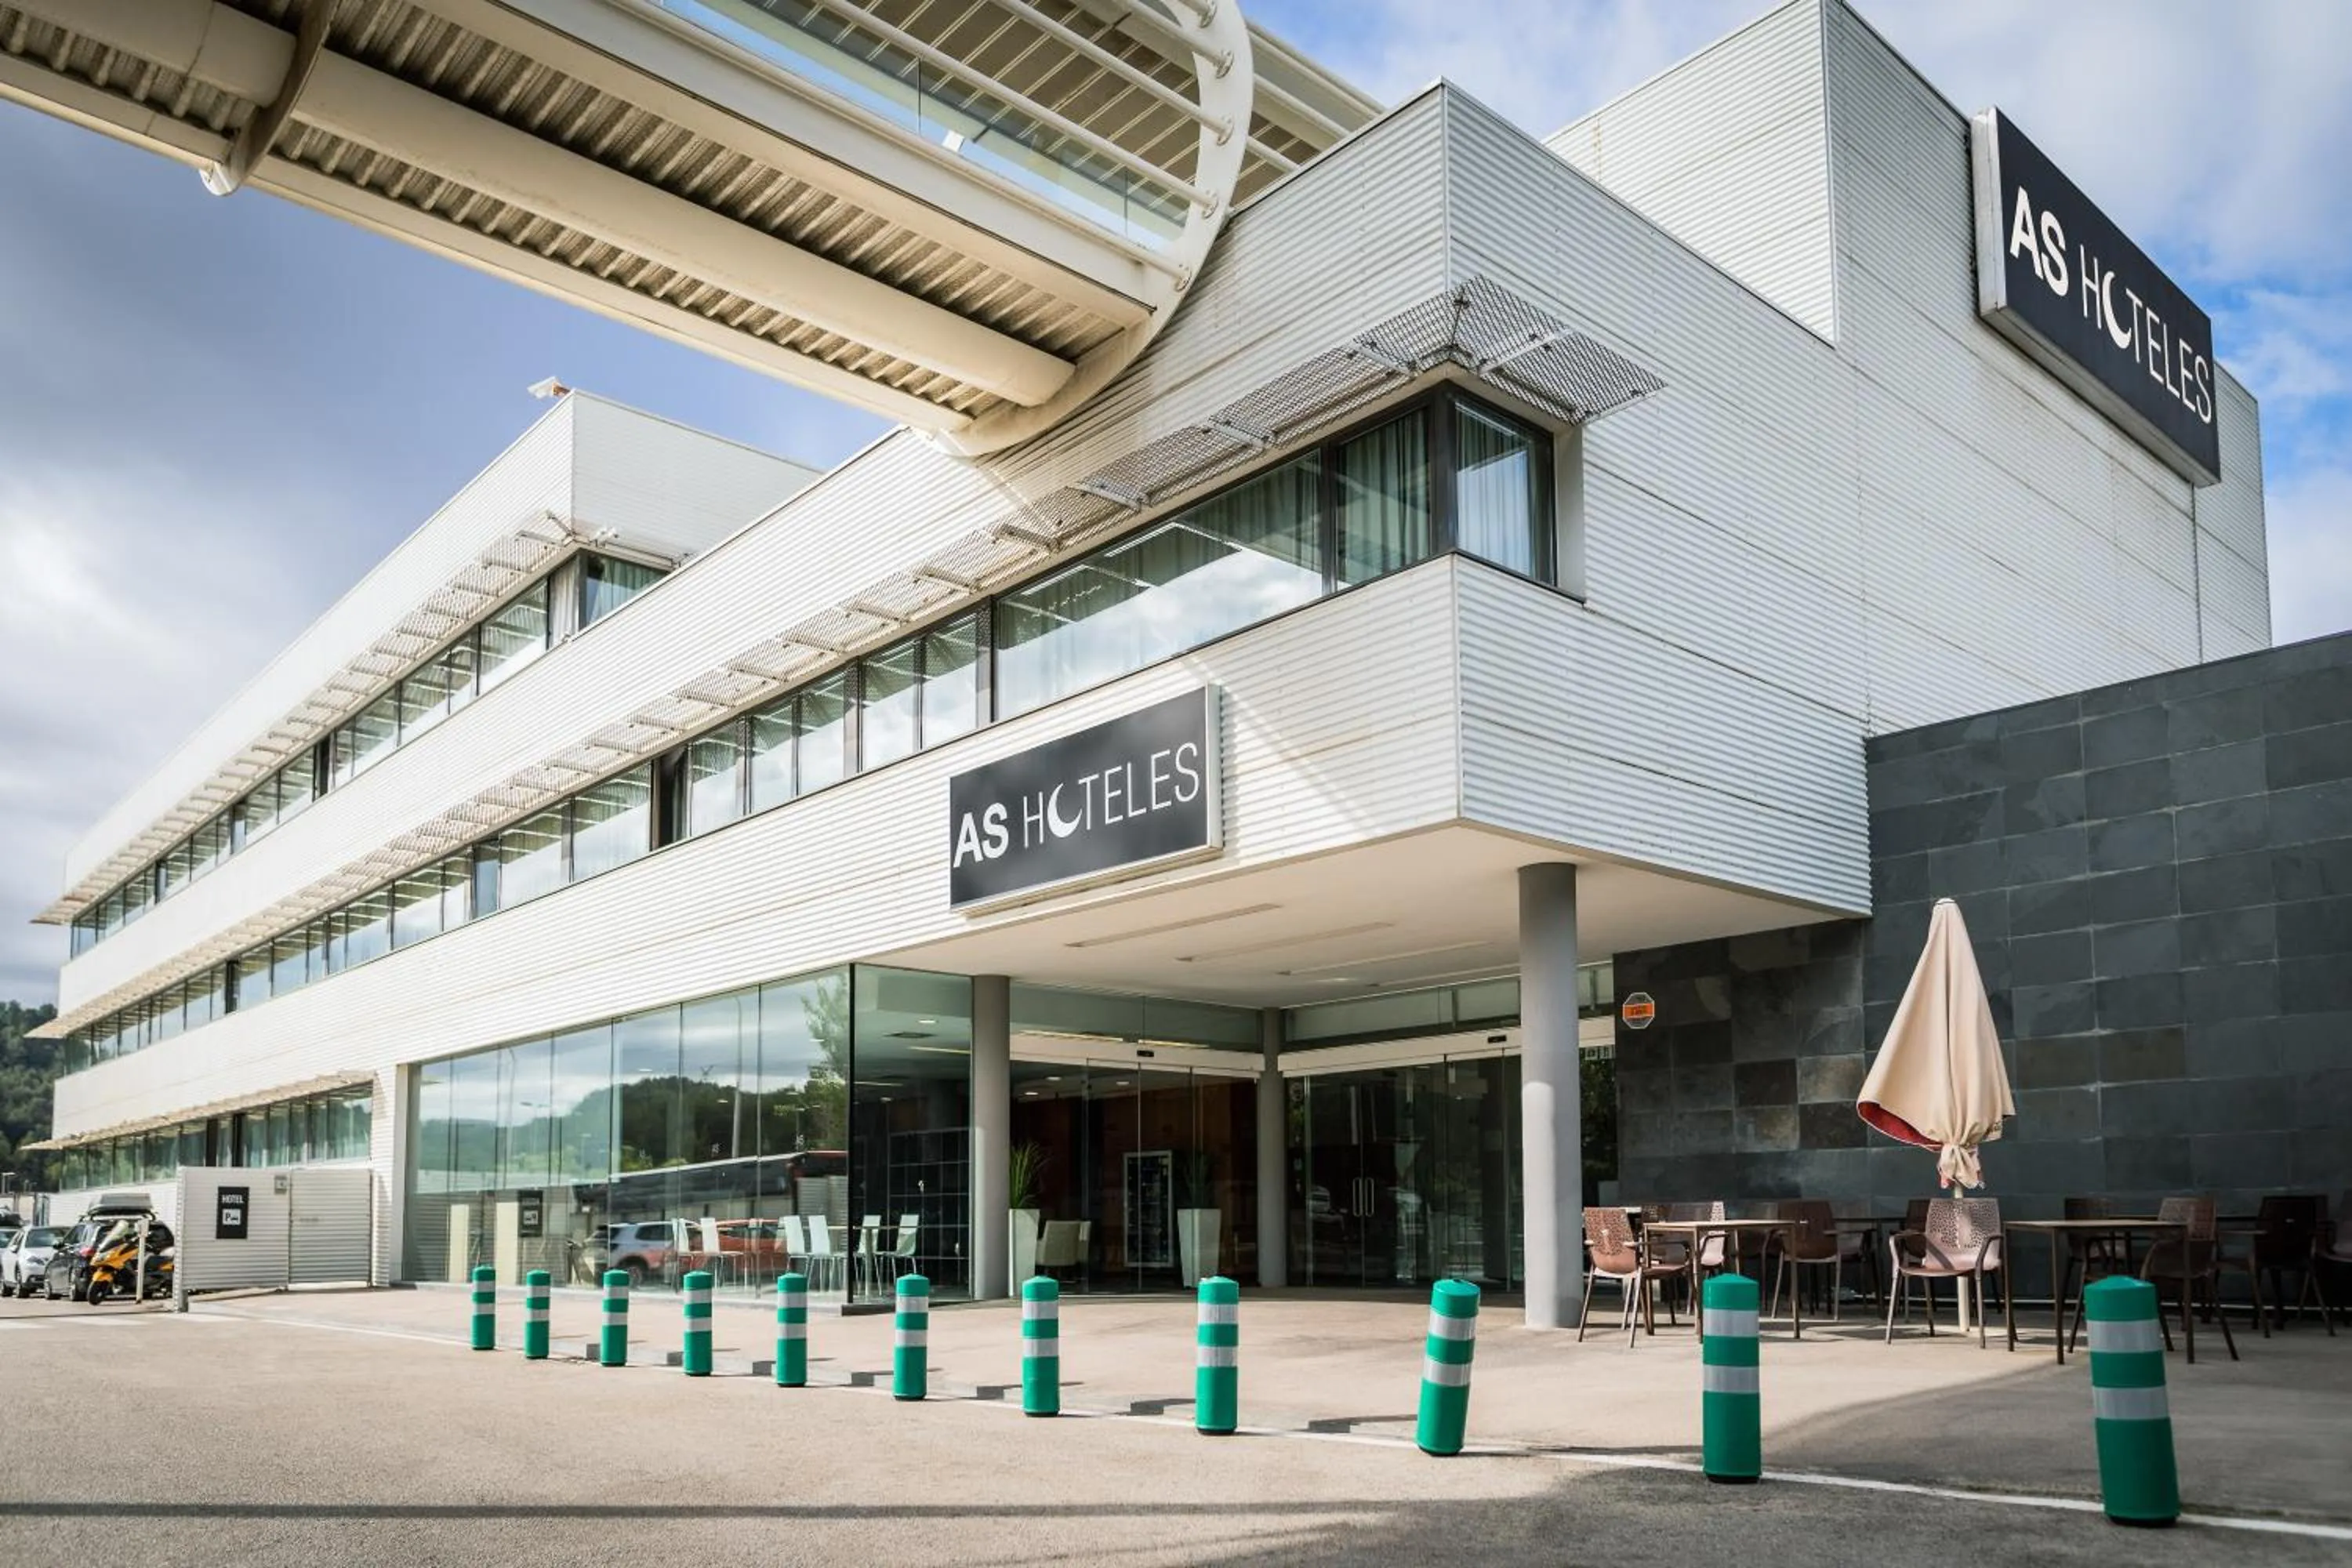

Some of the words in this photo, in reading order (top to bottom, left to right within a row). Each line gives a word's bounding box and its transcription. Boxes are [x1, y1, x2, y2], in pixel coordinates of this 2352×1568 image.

[2009, 185, 2069, 297] AS
[953, 801, 1010, 868] AS
[222, 1194, 245, 1203] HOTEL
